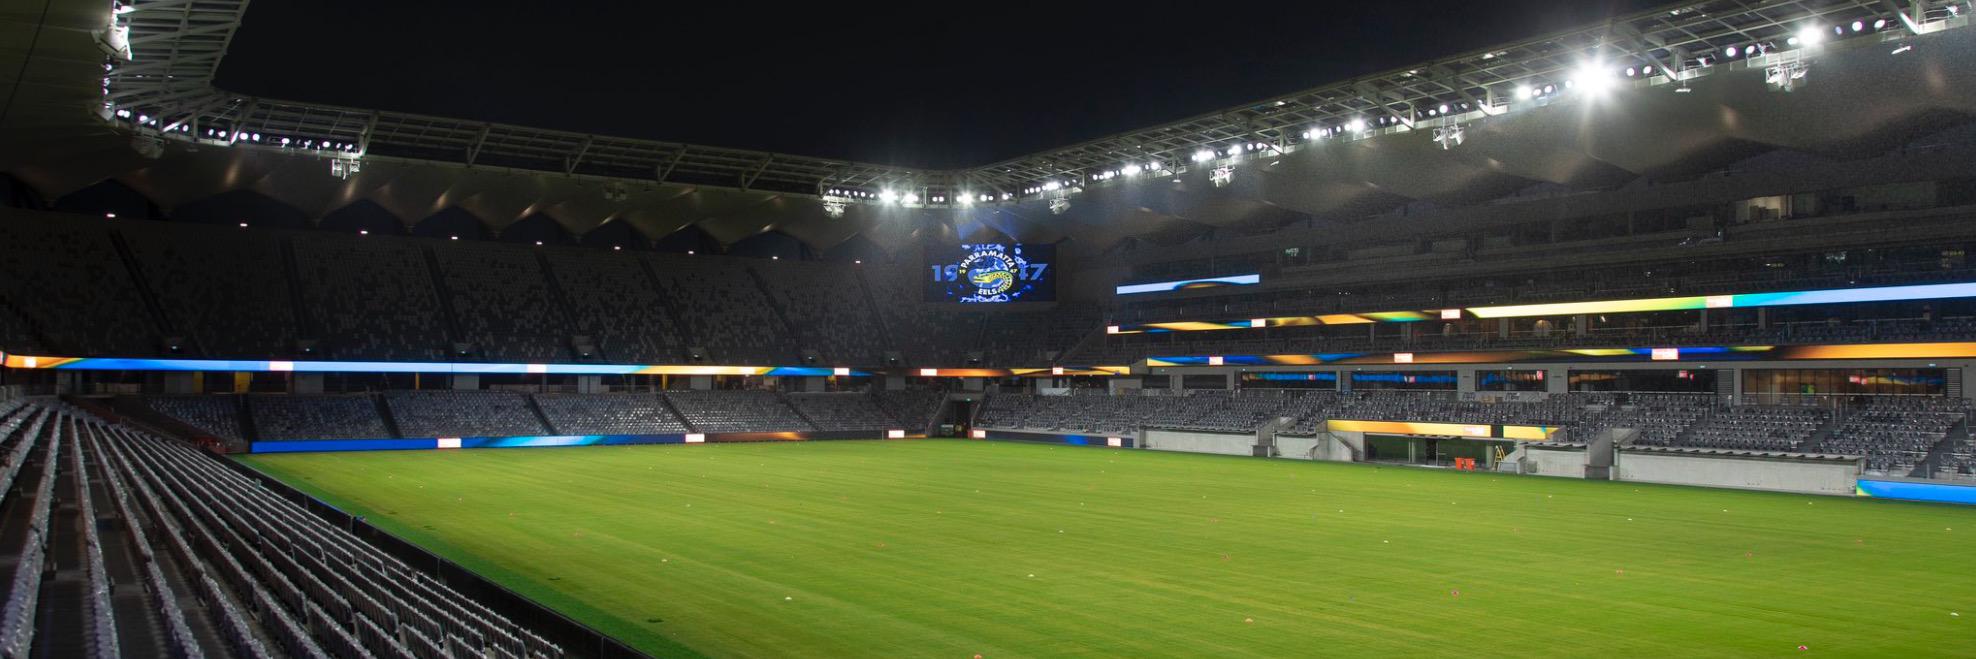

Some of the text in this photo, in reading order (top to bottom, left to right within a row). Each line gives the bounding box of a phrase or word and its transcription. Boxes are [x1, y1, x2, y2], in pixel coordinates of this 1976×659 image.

[960, 250, 1015, 268] PARRAMATTA
[932, 263, 1048, 281] 19 47
